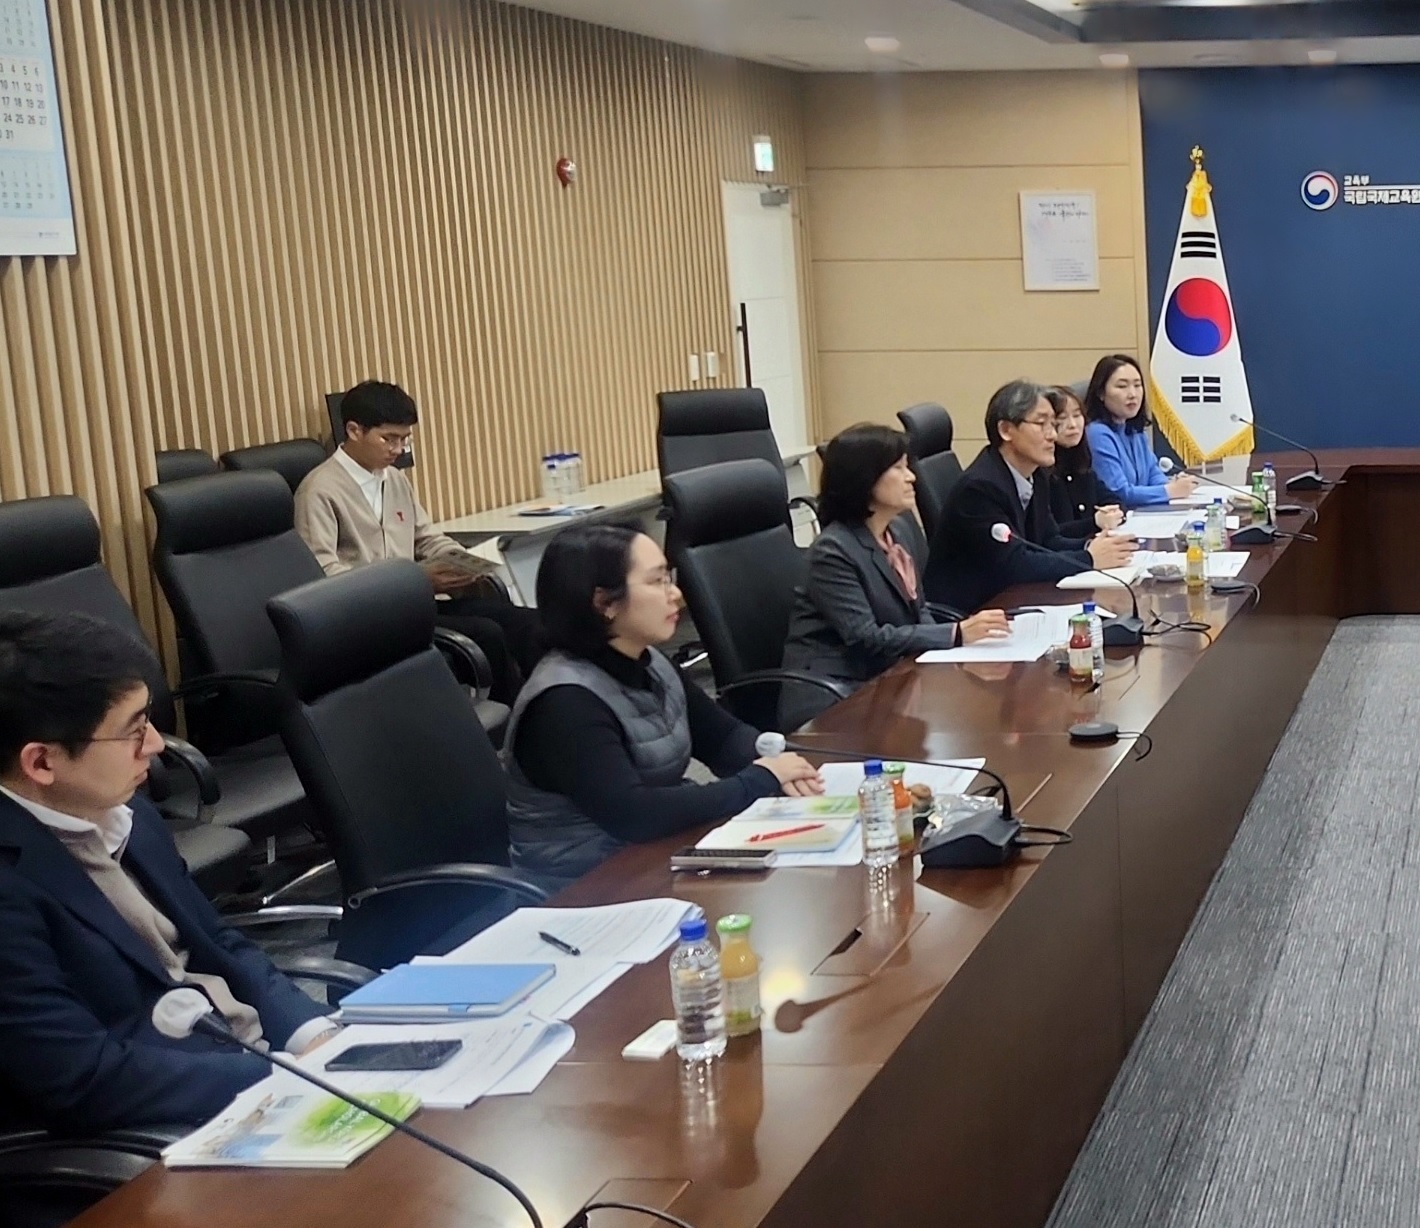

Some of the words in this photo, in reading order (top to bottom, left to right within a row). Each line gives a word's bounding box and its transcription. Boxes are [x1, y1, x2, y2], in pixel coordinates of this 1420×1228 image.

[11, 64, 16, 73] 4
[22, 65, 28, 75] 5
[11, 81, 20, 91] 11
[23, 82, 32, 92] 12
[1, 96, 10, 106] 17
[25, 98, 34, 108] 19
[3, 112, 12, 122] 24
[15, 113, 24, 124] 25
[27, 114, 36, 124] 26
